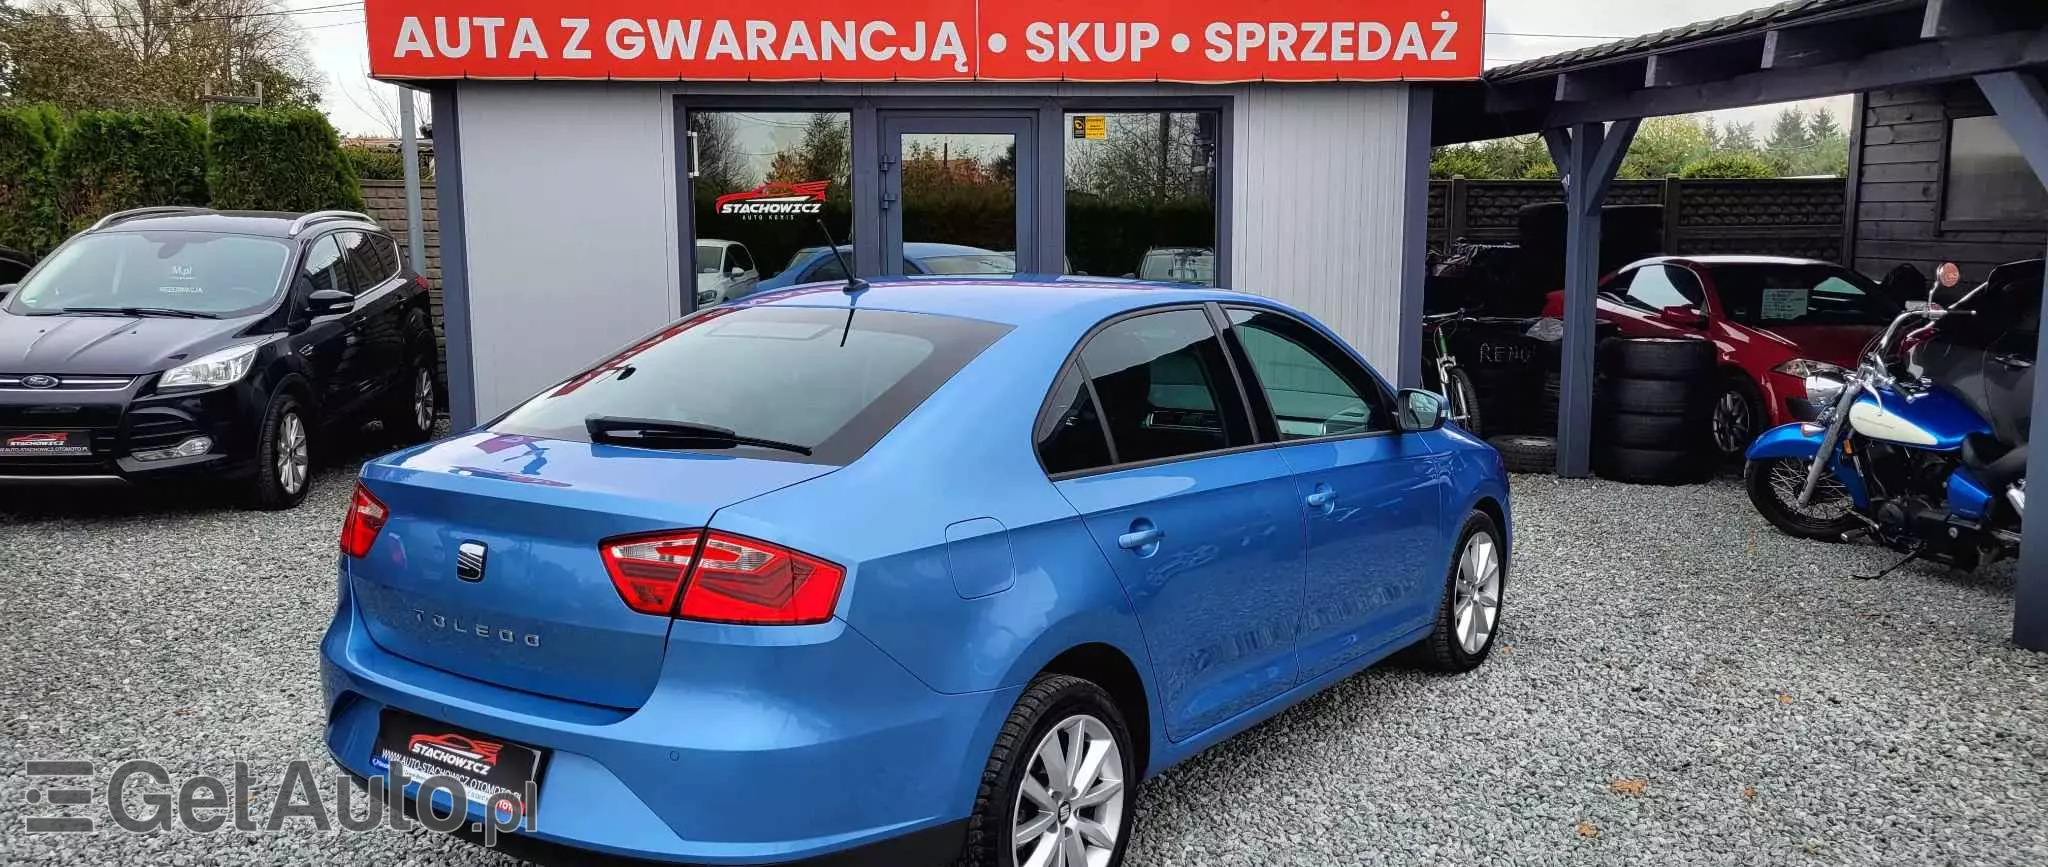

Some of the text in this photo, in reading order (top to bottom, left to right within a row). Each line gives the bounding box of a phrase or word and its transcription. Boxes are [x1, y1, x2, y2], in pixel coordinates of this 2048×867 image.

[393, 10, 1458, 73] AUTA Z GWARANCJĄ SKUP SPRZEDAŻ
[721, 203, 822, 214] STACHOWICZ
[410, 608, 540, 647] TOLEDO
[411, 742, 491, 776] STACHOWICZ
